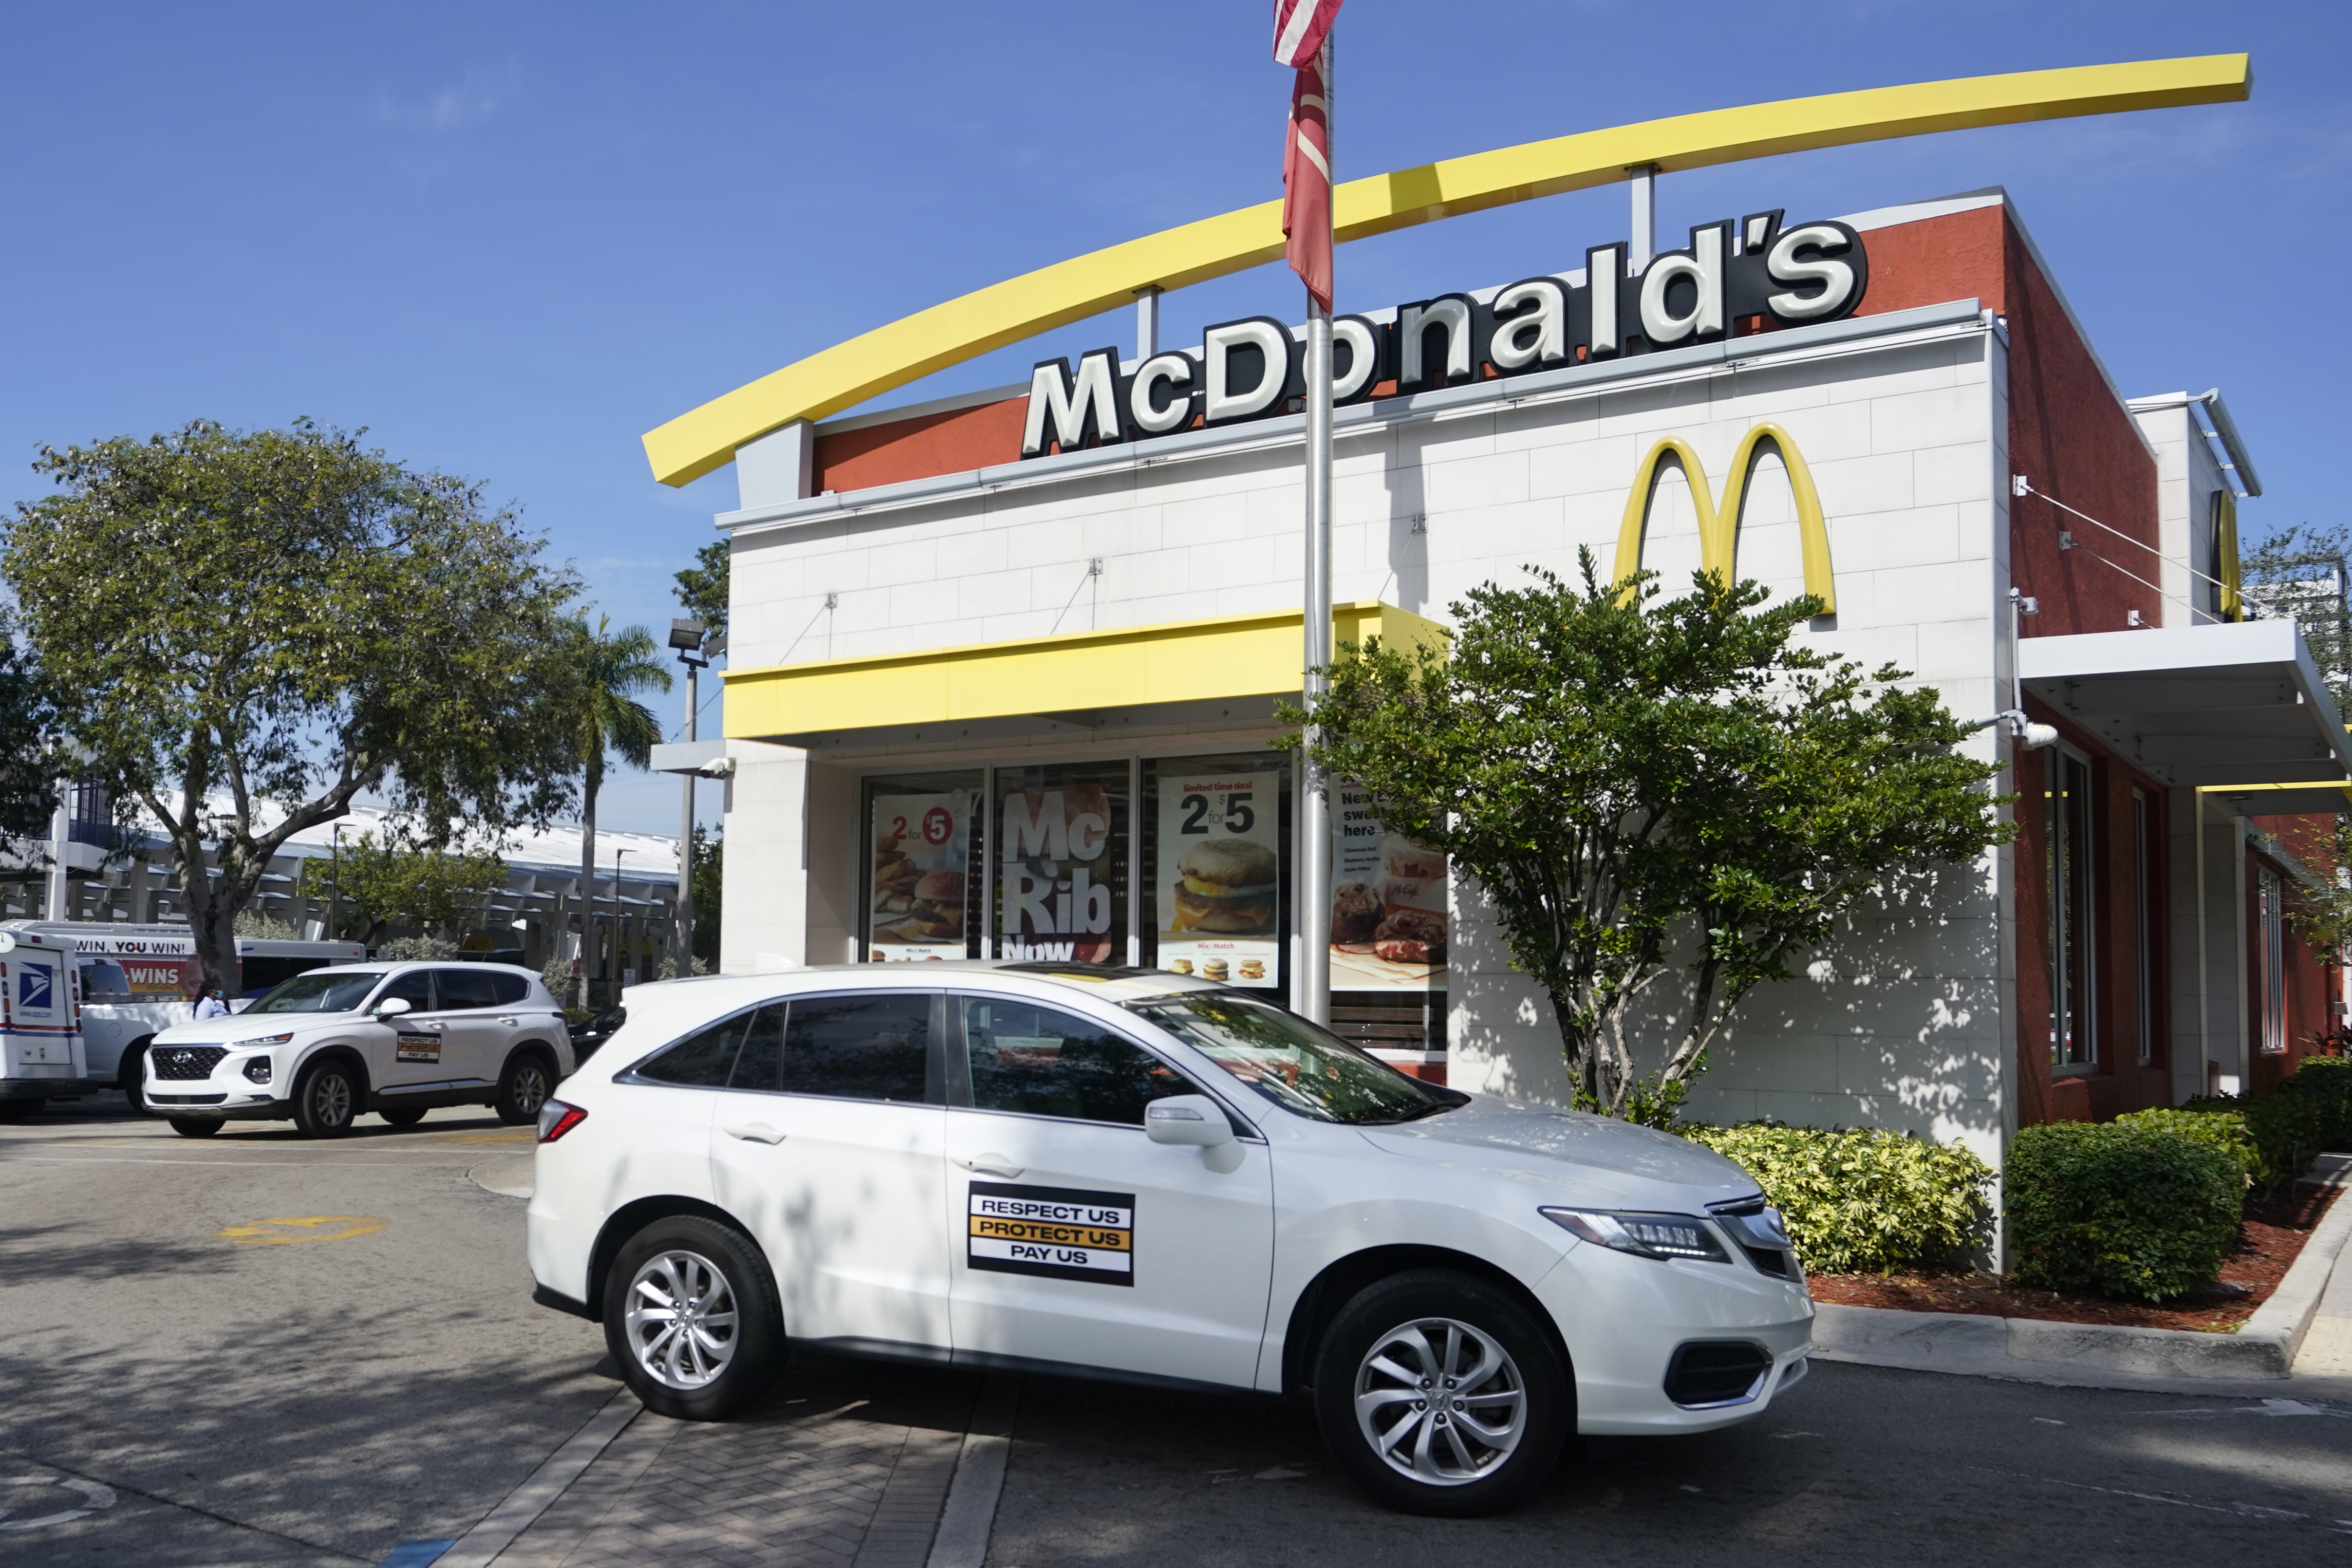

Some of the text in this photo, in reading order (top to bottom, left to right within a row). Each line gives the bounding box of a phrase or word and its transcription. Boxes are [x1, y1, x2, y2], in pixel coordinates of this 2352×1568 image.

[1025, 212, 1859, 451] McDonald's
[1183, 781, 1252, 792] limited time deal
[1180, 792, 1254, 835] 2 for $5
[893, 816, 907, 840] 2
[909, 829, 922, 840] for
[1002, 790, 1106, 862] Mc
[1344, 824, 1376, 837] here
[1002, 862, 1111, 934] Rib
[115, 942, 146, 953] YOU
[151, 943, 185, 954] WIN!
[982, 1200, 1120, 1224] RESPECT US
[980, 1221, 1120, 1246] PROTECT US
[1011, 1245, 1087, 1264] PAY US
